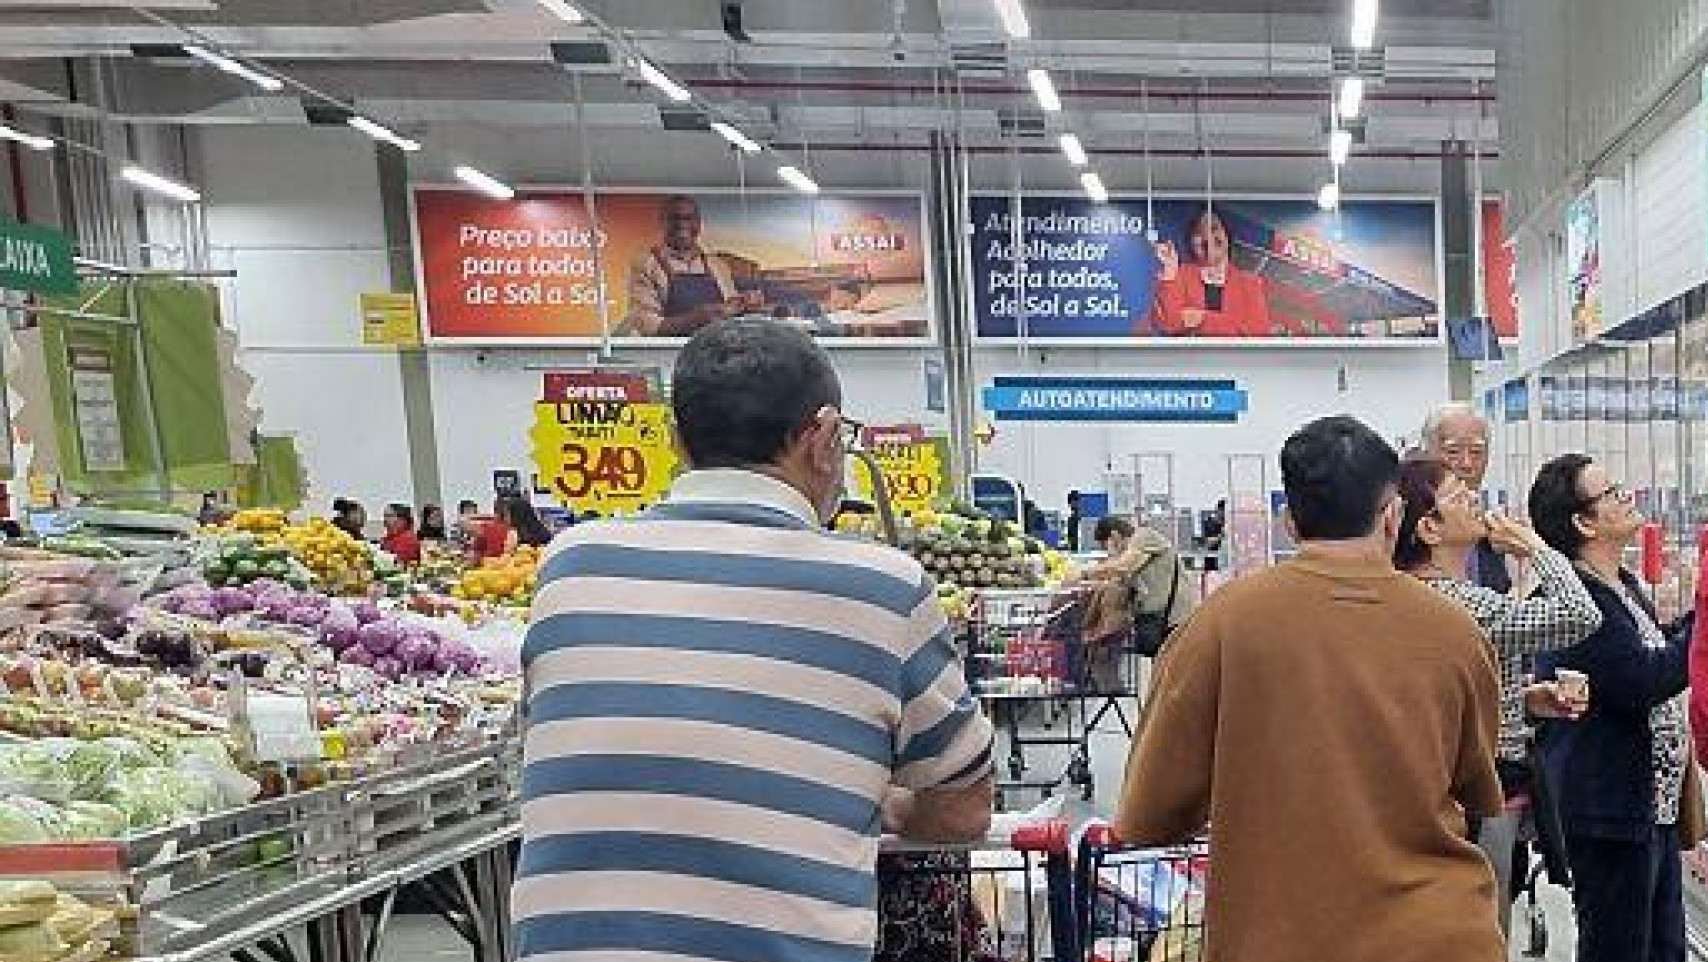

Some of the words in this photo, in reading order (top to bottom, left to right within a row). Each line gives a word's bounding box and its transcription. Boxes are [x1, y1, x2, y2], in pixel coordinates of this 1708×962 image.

[460, 226, 531, 250] Preço
[538, 226, 607, 248] baixo
[988, 240, 1108, 261] Acolhedor
[463, 256, 521, 281] para
[467, 280, 497, 305] de
[504, 280, 541, 305] Sol
[547, 286, 562, 305] a
[988, 269, 1042, 295] para
[990, 293, 1021, 317] de
[1024, 293, 1059, 318] Sol
[1064, 299, 1079, 316] a
[1085, 293, 1129, 318] Sol.
[566, 385, 627, 401] OFERTA
[1017, 388, 1213, 410] AUTOATENDIMENTO
